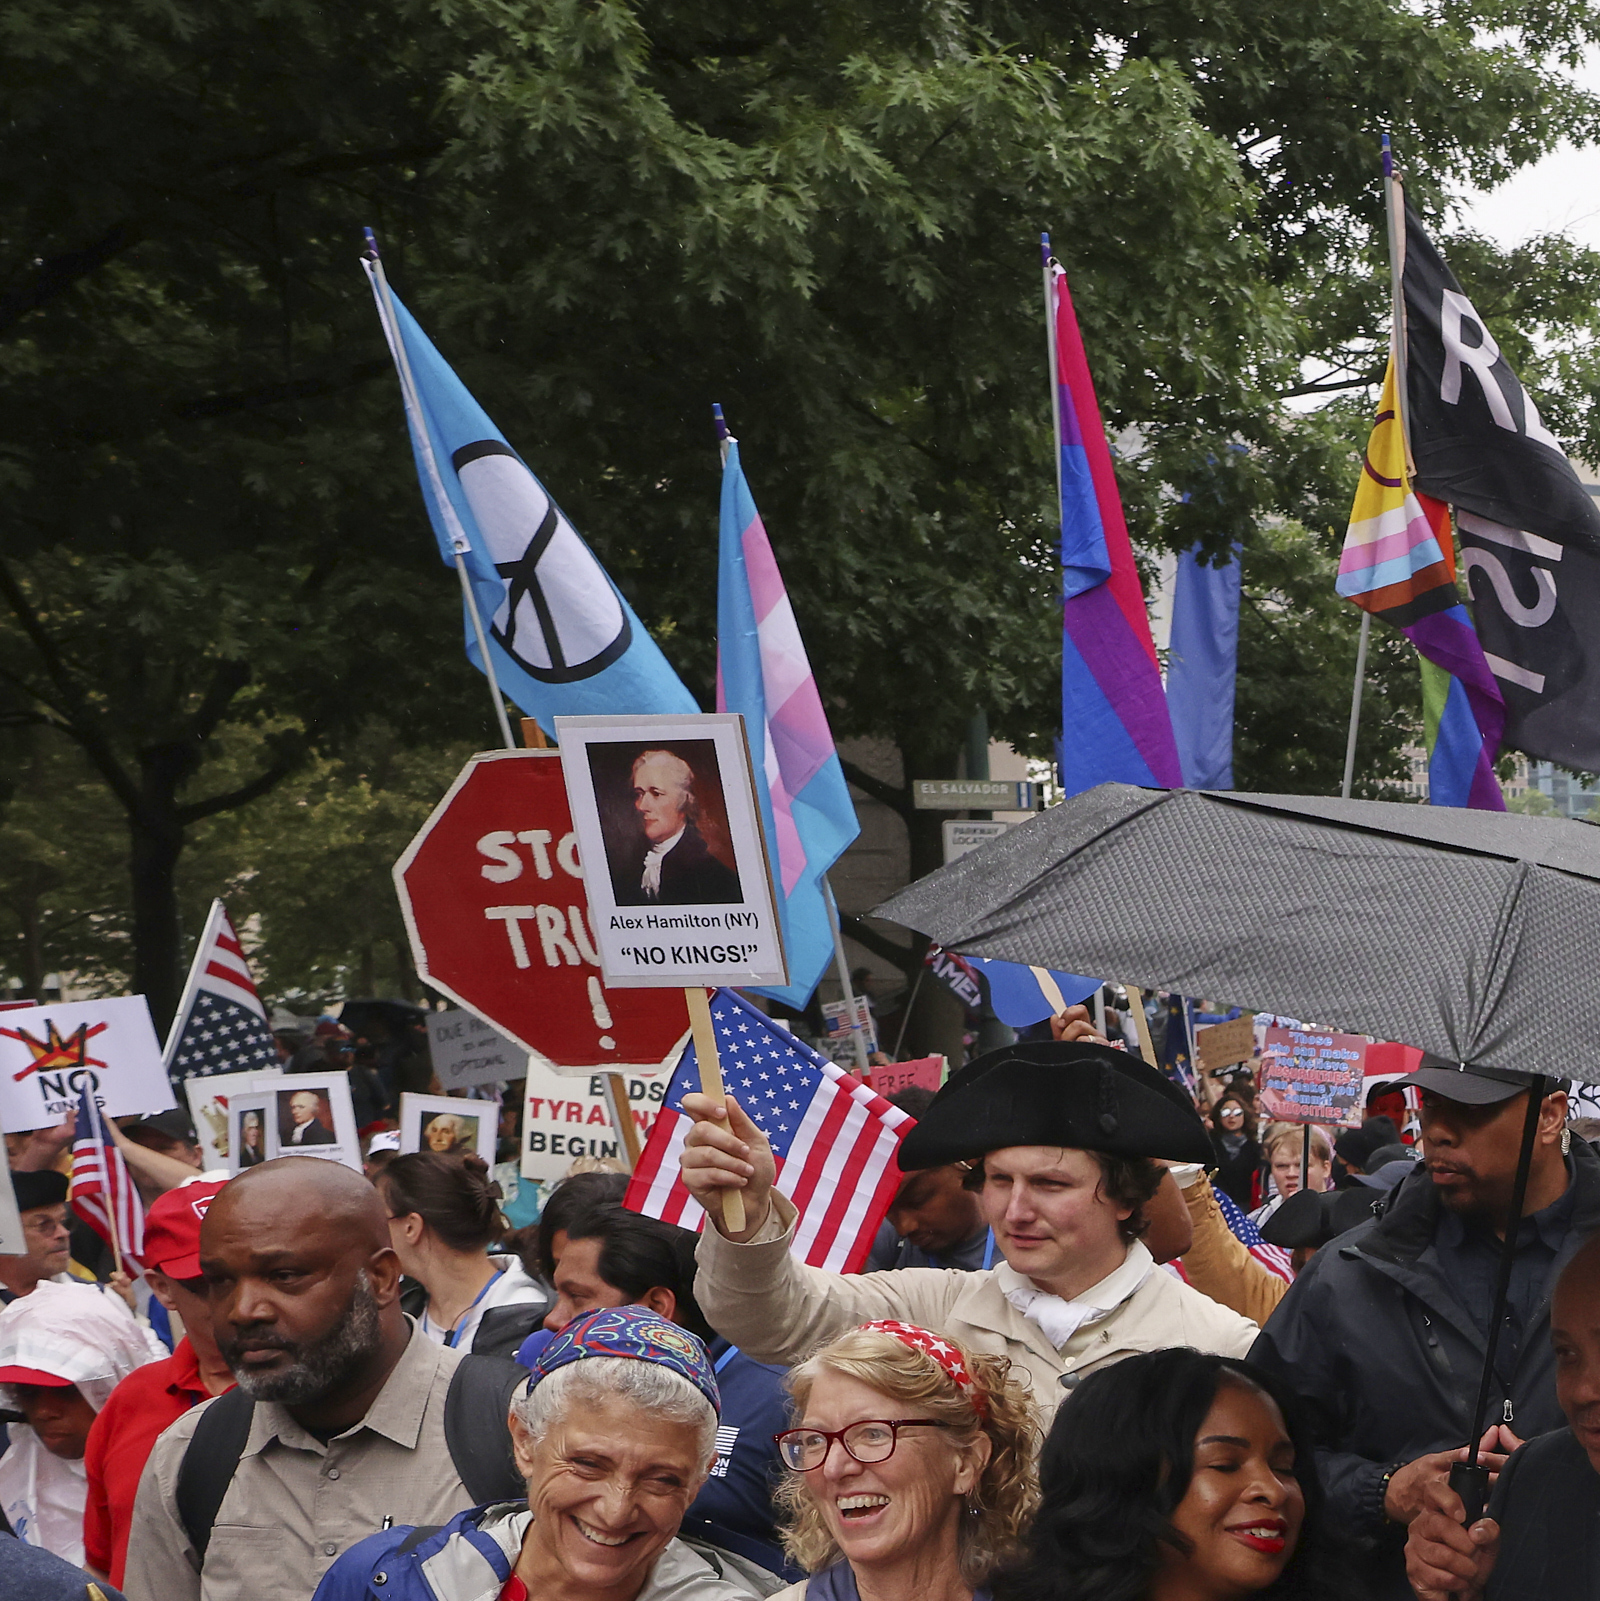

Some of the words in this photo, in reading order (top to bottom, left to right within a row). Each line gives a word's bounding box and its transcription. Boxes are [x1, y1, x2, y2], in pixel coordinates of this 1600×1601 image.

[476, 829, 584, 883] STO
[610, 915, 643, 930] Alex
[648, 914, 720, 929] Hamilton
[724, 912, 759, 930] (NY)
[485, 904, 601, 969] TRU
[621, 946, 665, 966] “NO
[671, 943, 757, 964] KINGS!”
[587, 975, 616, 1050] !
[37, 1069, 99, 1100] NO
[589, 1075, 665, 1101] EDS
[45, 1096, 106, 1115] KINS
